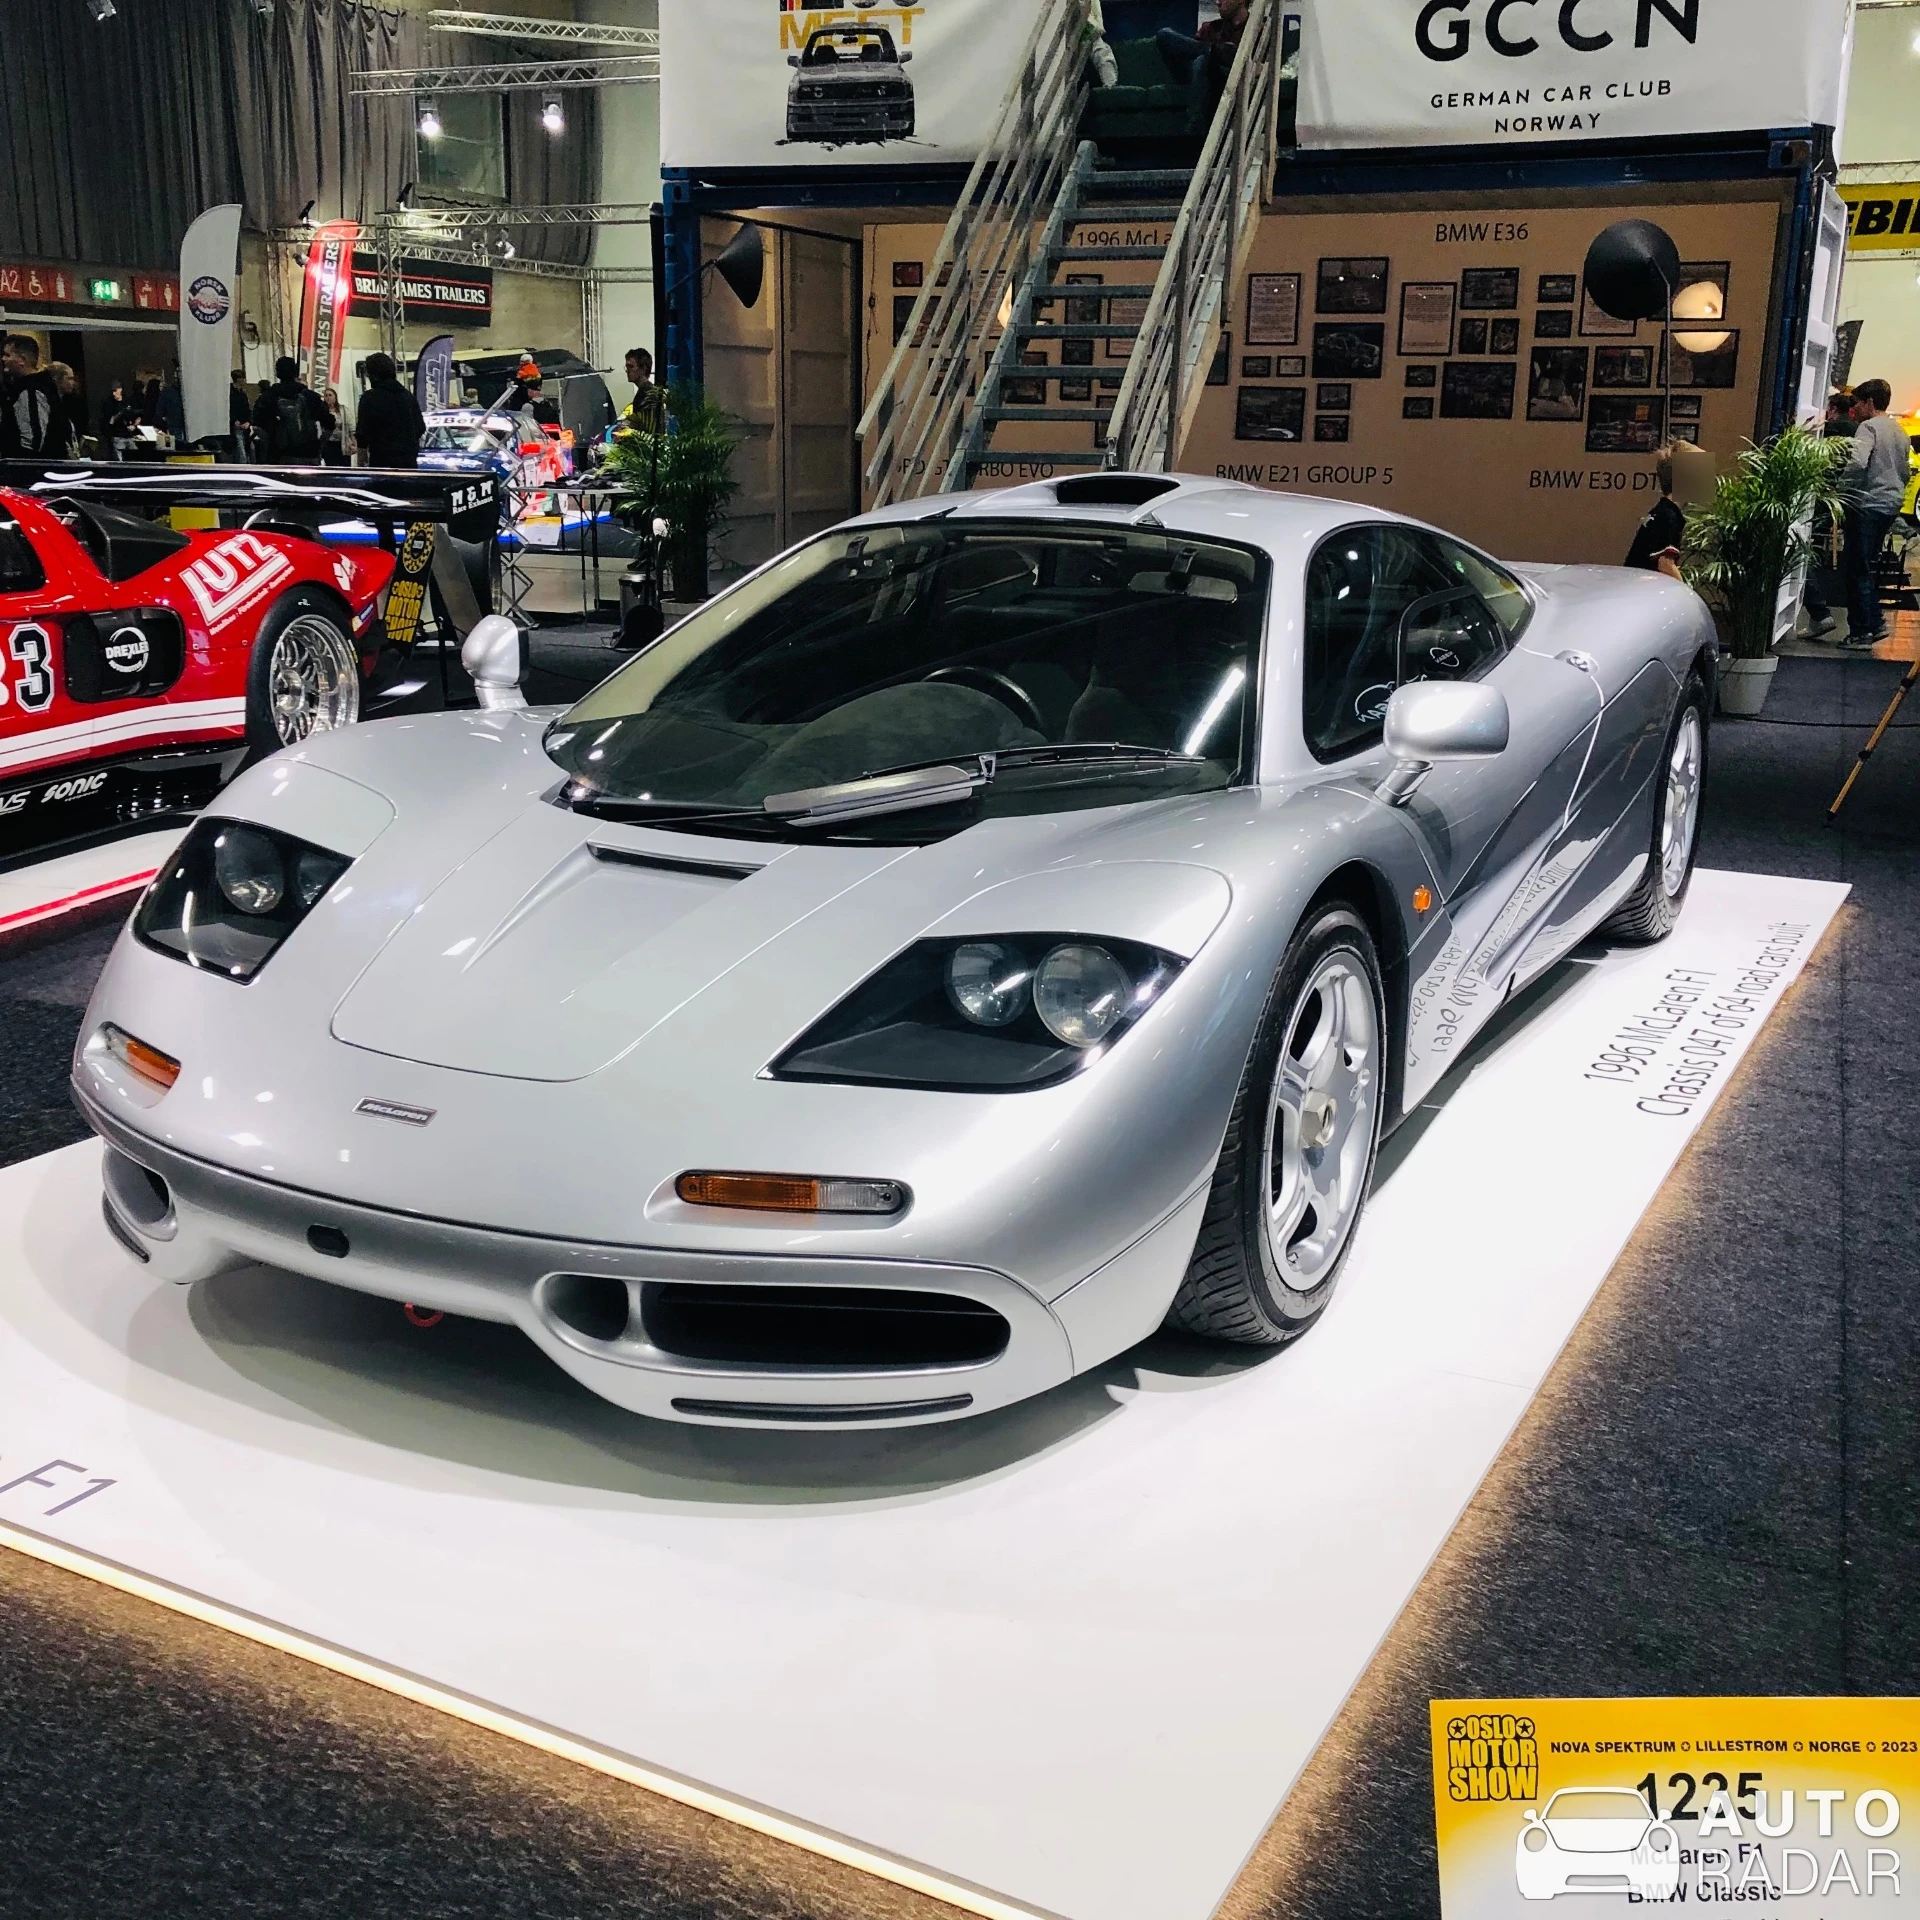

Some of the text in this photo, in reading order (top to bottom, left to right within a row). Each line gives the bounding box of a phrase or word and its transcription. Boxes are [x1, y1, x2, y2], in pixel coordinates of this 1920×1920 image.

[779, 8, 925, 49] MEET
[1415, 0, 1699, 61] GCCN
[1431, 80, 1672, 108] GERMAN CAR CLUB
[1495, 113, 1601, 133] NORWAY
[1077, 230, 1120, 246] 1996
[1435, 222, 1529, 242] BMW E36
[194, 279, 223, 292] NORSK
[394, 279, 432, 299] JAMES
[434, 285, 486, 304] TRAILERS
[315, 320, 331, 373] JAMES
[1019, 462, 1054, 478] EVO
[1216, 464, 1393, 485] BMW E21 GROUP 5
[1529, 470, 1660, 491] BMW E30 DT
[178, 533, 291, 626] LUTZ
[386, 596, 421, 620] MOTOR
[385, 615, 417, 642] SHOW
[0, 622, 55, 713] 3
[41, 772, 108, 803] SONIC
[1583, 969, 1717, 1083] 1996 McLaren F1
[1636, 922, 1811, 1116] Chassis 047 of 64 road cars built
[361, 1102, 430, 1121] McLaren
[0, 1459, 118, 1516] F1
[1466, 1715, 1517, 1740] OSLO
[1449, 1739, 1538, 1768] MOTOR
[1550, 1740, 1918, 1754] NOVA SPEKTRUM LILLESTRØM NORGE 2023
[1449, 1767, 1539, 1801] SHOW
[1738, 1843, 1763, 1863] F1
[1696, 1880, 1783, 1902] Classic
